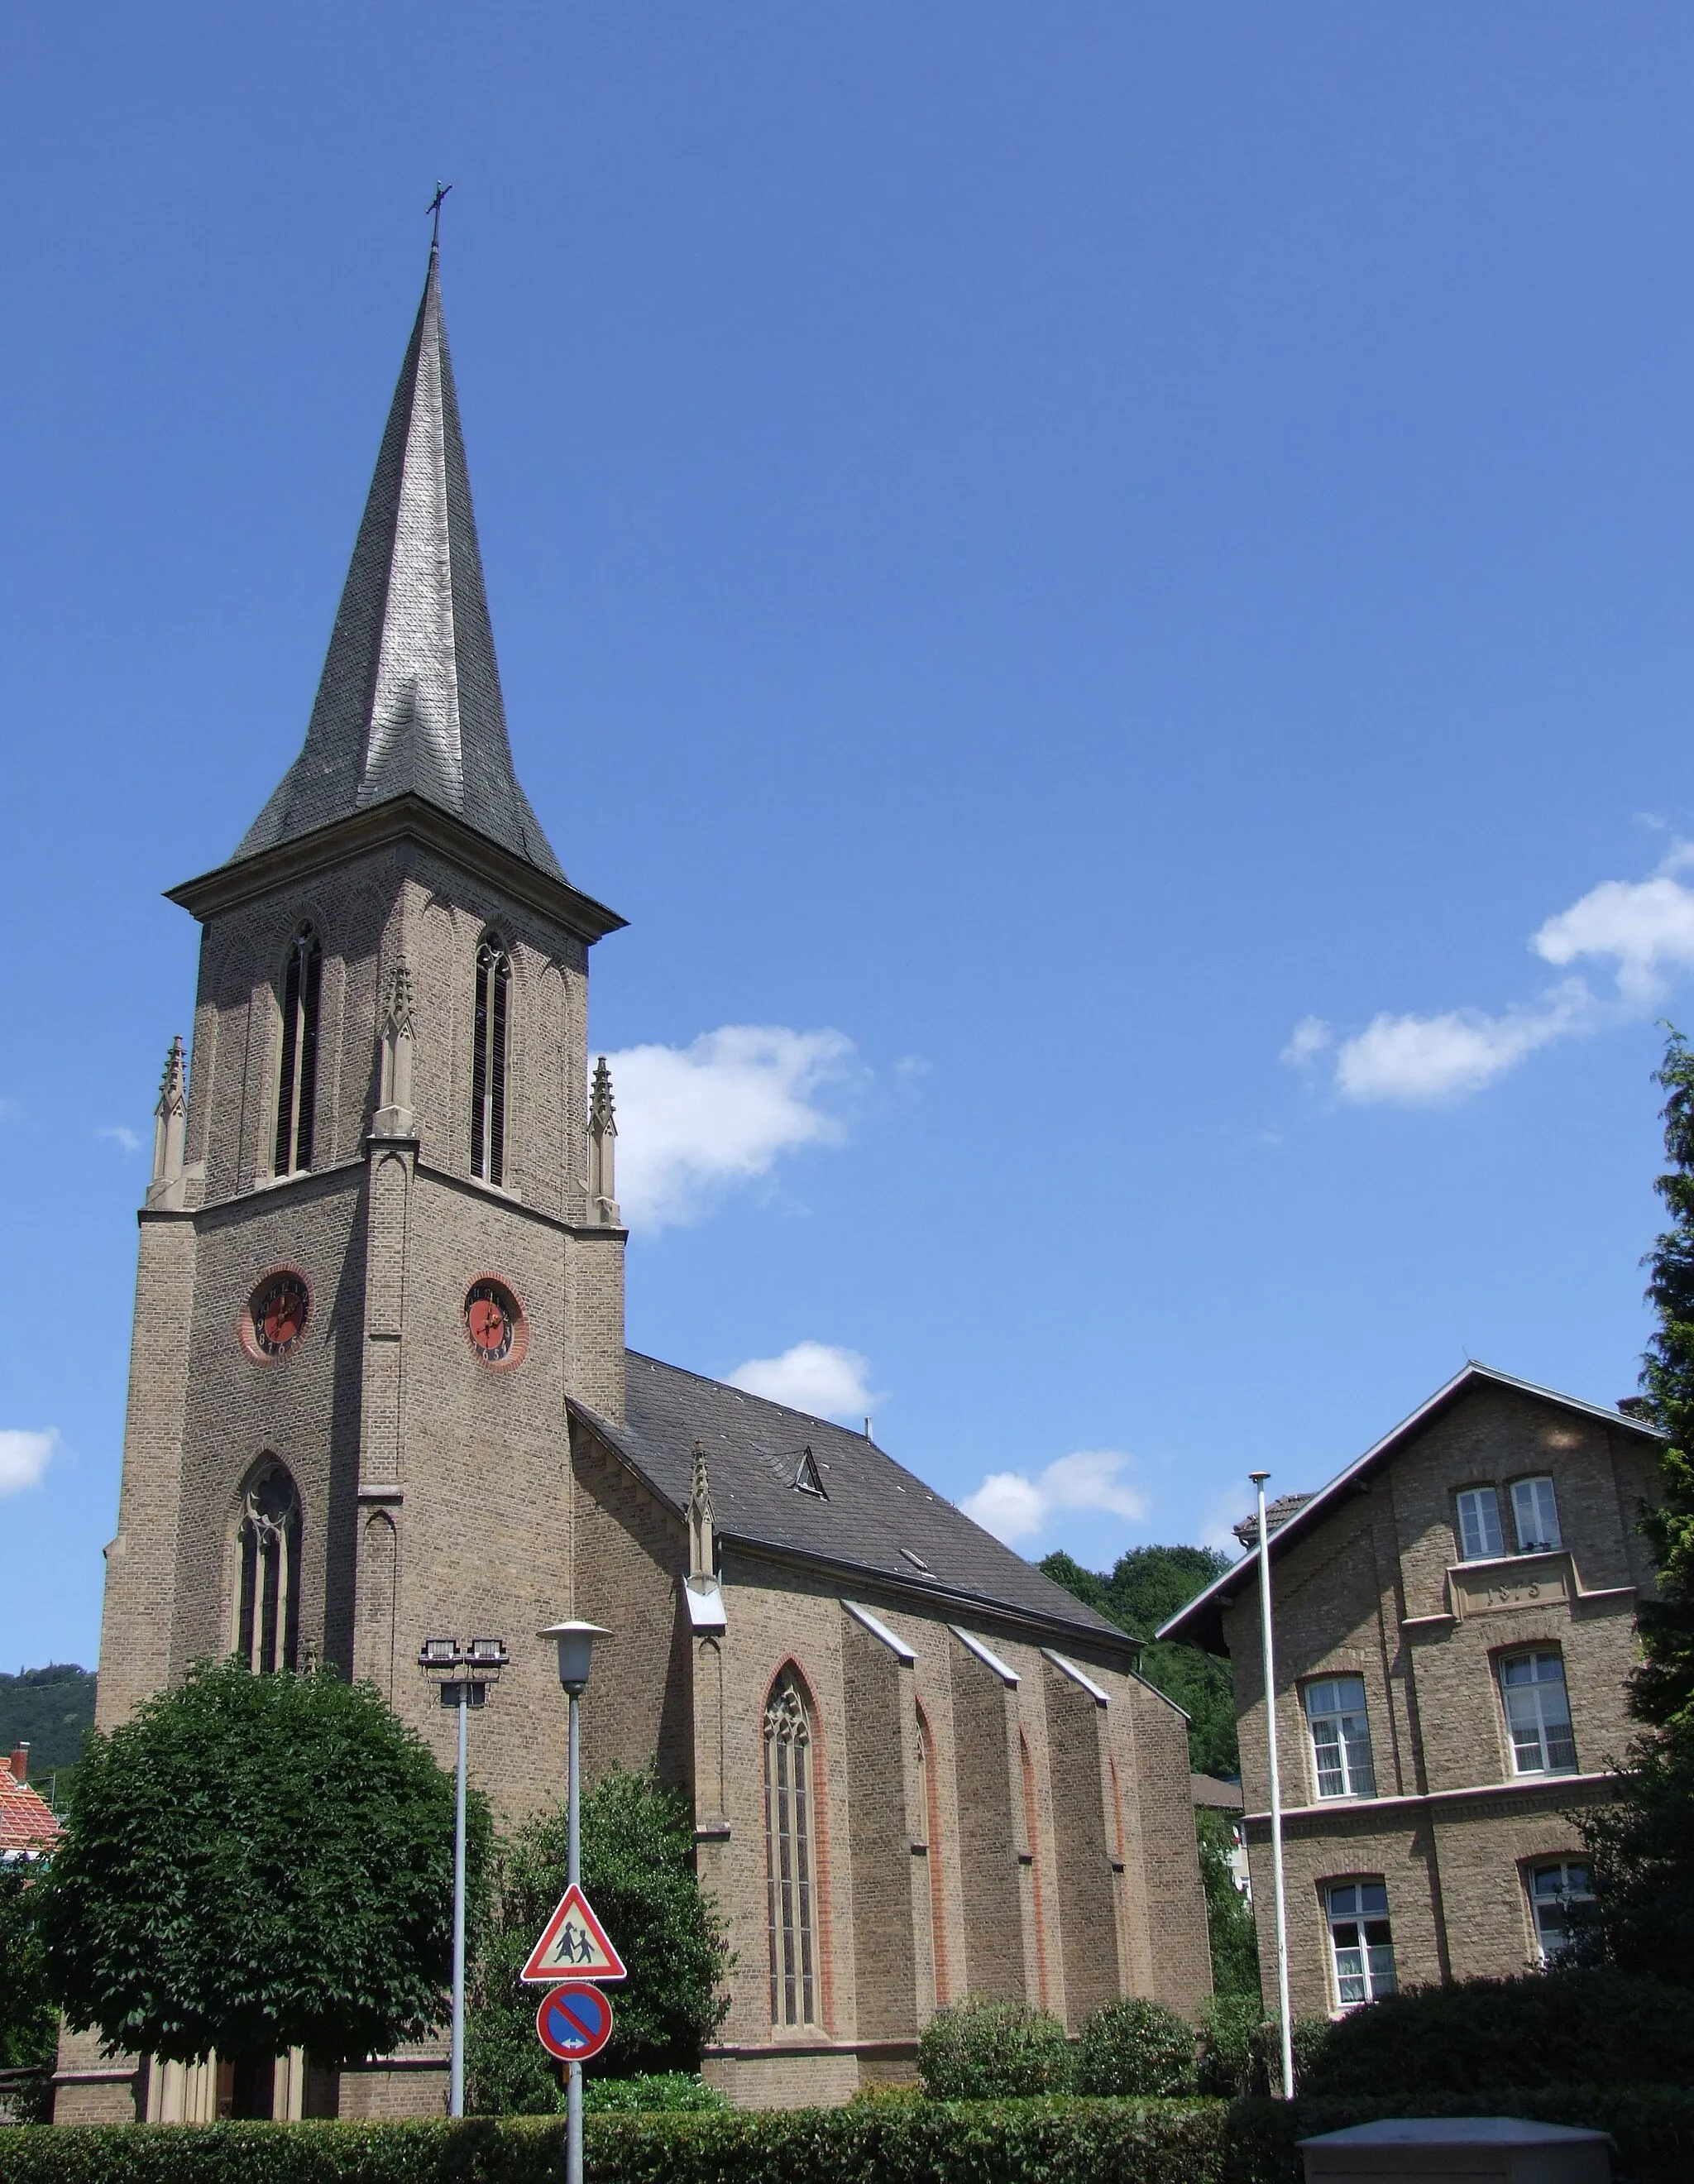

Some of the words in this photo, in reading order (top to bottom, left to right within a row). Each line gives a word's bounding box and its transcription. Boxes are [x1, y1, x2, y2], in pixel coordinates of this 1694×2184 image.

[257, 1319, 264, 1329] 9
[506, 1327, 510, 1338] 3
[259, 1334, 265, 1344] 8
[279, 1343, 285, 1354] 6
[501, 1340, 506, 1352] 4
[483, 1349, 488, 1360] 6
[494, 1349, 499, 1359] 5
